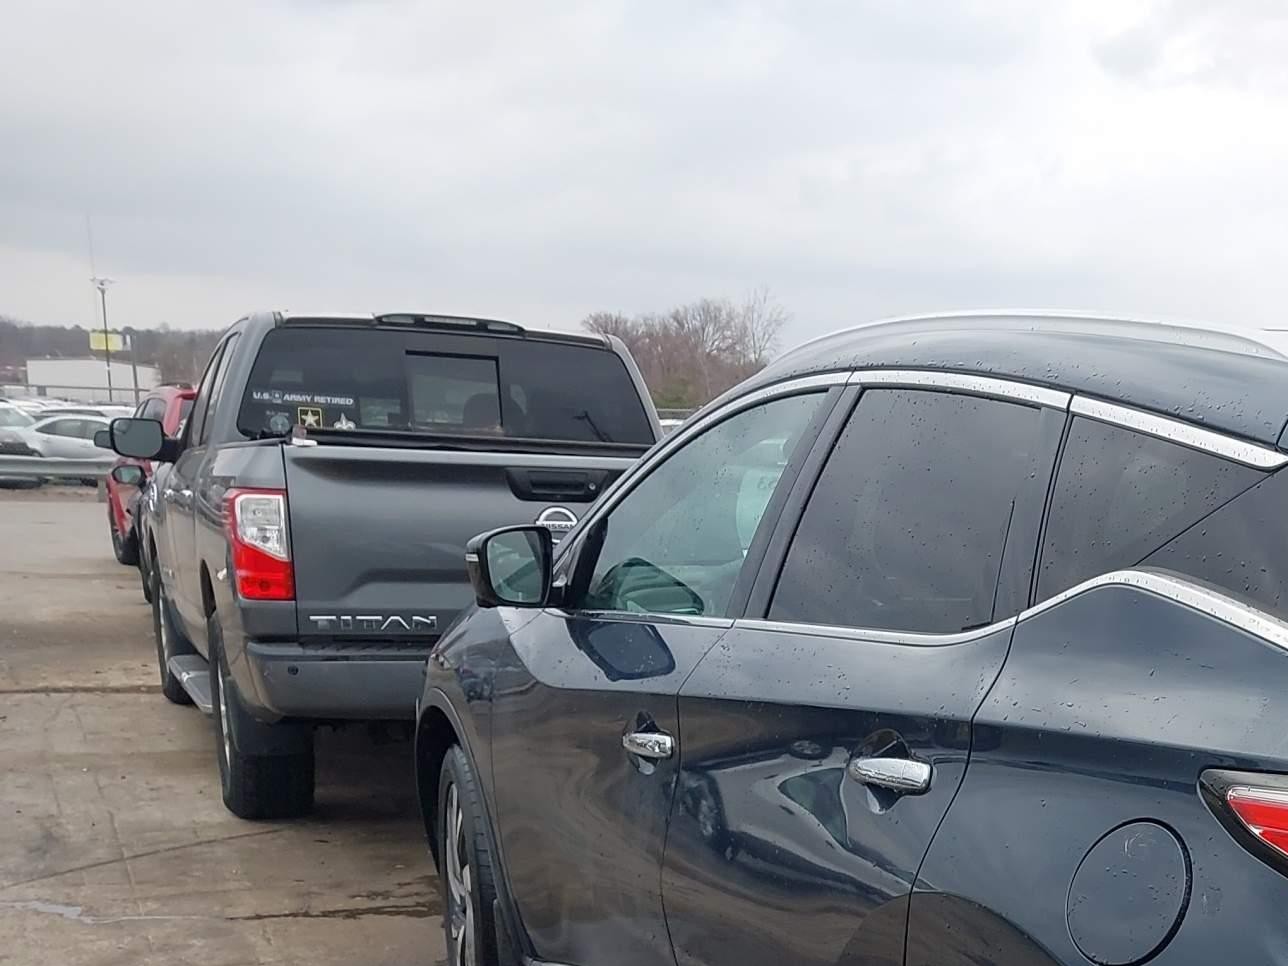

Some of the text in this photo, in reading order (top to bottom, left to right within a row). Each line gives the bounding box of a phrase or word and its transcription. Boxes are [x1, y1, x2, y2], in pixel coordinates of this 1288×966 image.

[283, 393, 312, 402] ARMY
[314, 396, 354, 406] RETIRED
[309, 615, 438, 630] TITAN
